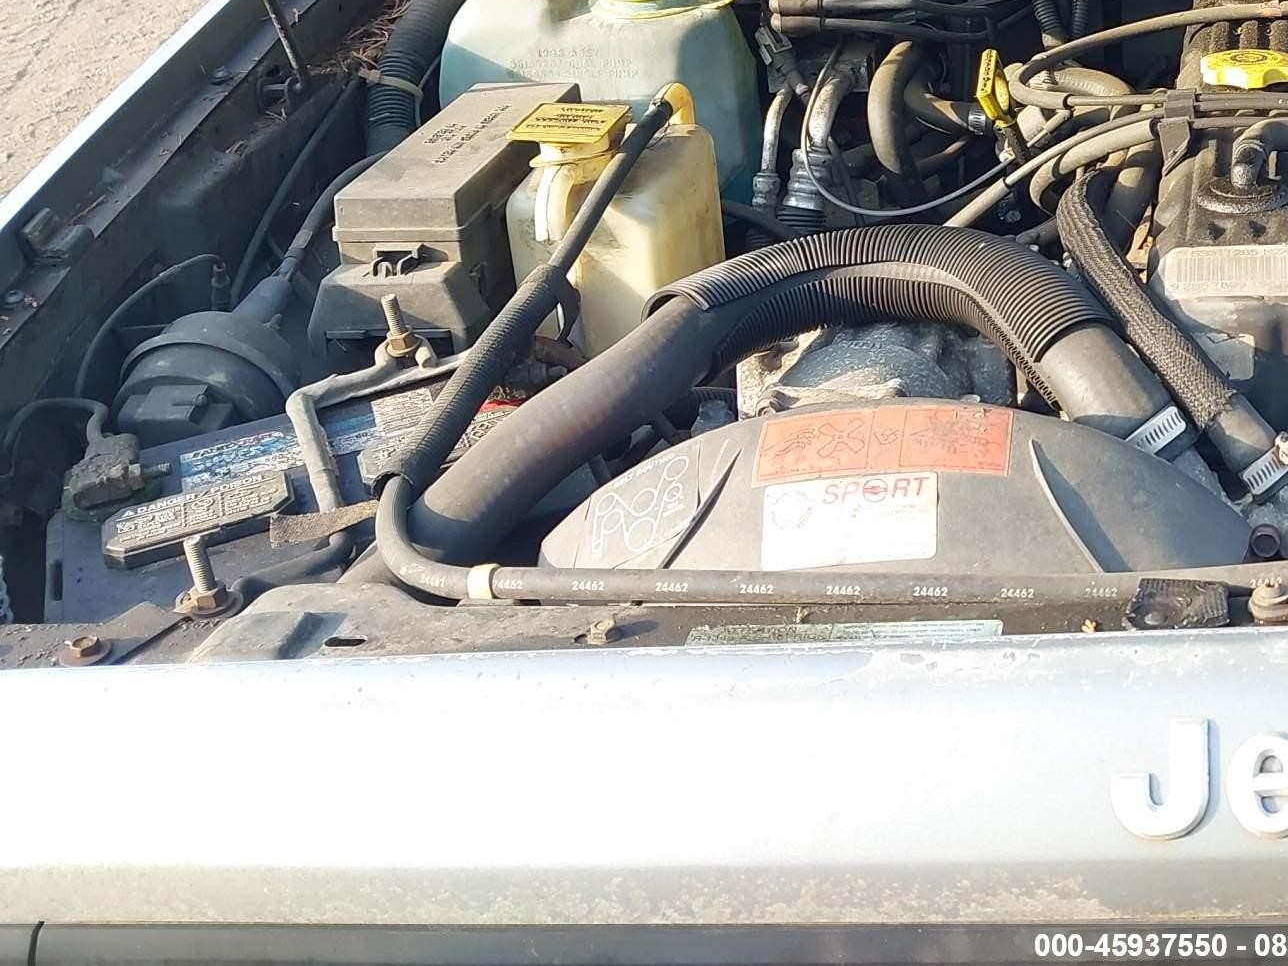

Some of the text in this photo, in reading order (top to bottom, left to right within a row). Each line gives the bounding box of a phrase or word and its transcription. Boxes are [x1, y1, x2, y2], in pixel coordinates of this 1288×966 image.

[137, 492, 199, 515] DANGER
[210, 475, 264, 495] POISON
[571, 580, 605, 592] 24462
[654, 581, 689, 594] 24462
[738, 583, 775, 596] 24462
[825, 584, 862, 598] 24462
[912, 584, 949, 598] 24462
[999, 585, 1036, 600] 24462
